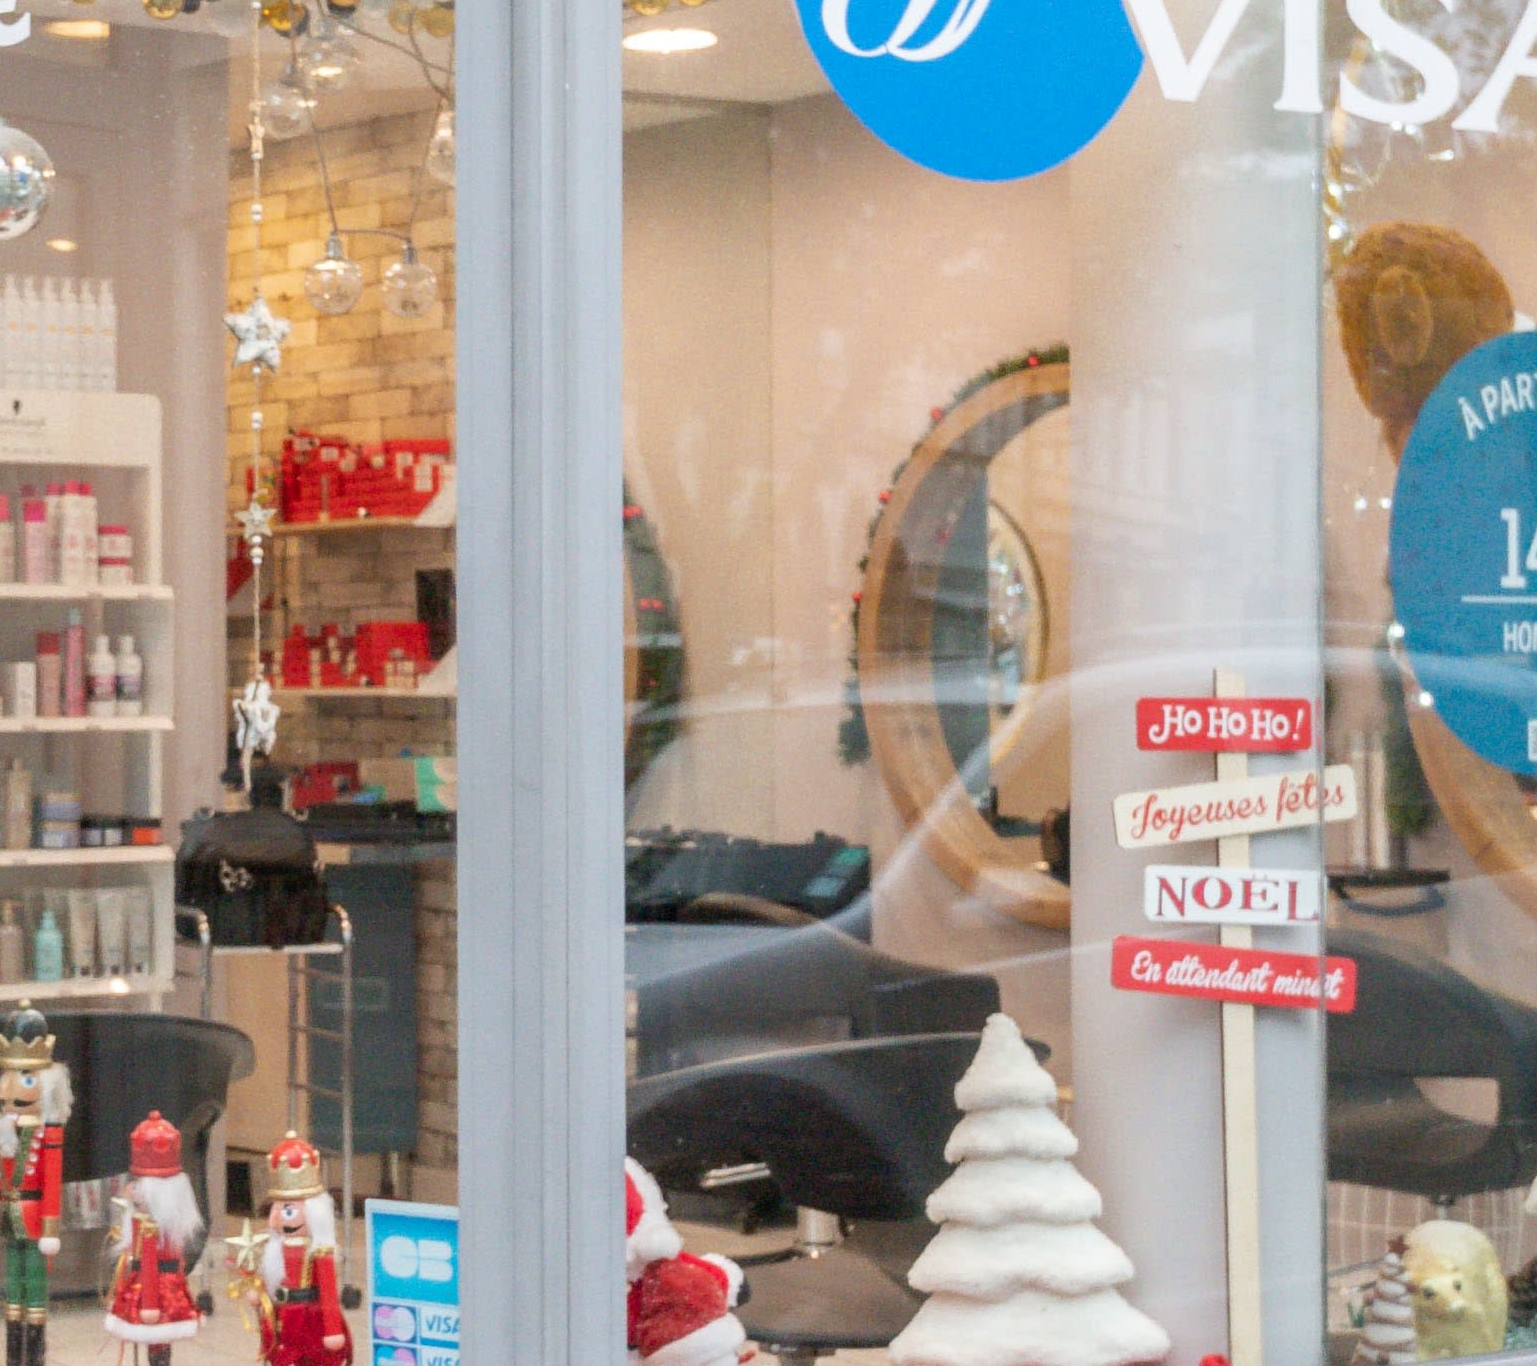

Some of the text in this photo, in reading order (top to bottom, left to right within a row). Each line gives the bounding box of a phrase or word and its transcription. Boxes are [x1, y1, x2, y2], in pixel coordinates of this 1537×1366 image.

[1459, 395, 1484, 441] À
[1131, 793, 1267, 840] Joyeuses
[1155, 876, 1320, 922] NOËL
[1130, 950, 1162, 982] En
[1165, 954, 1271, 995] attendant
